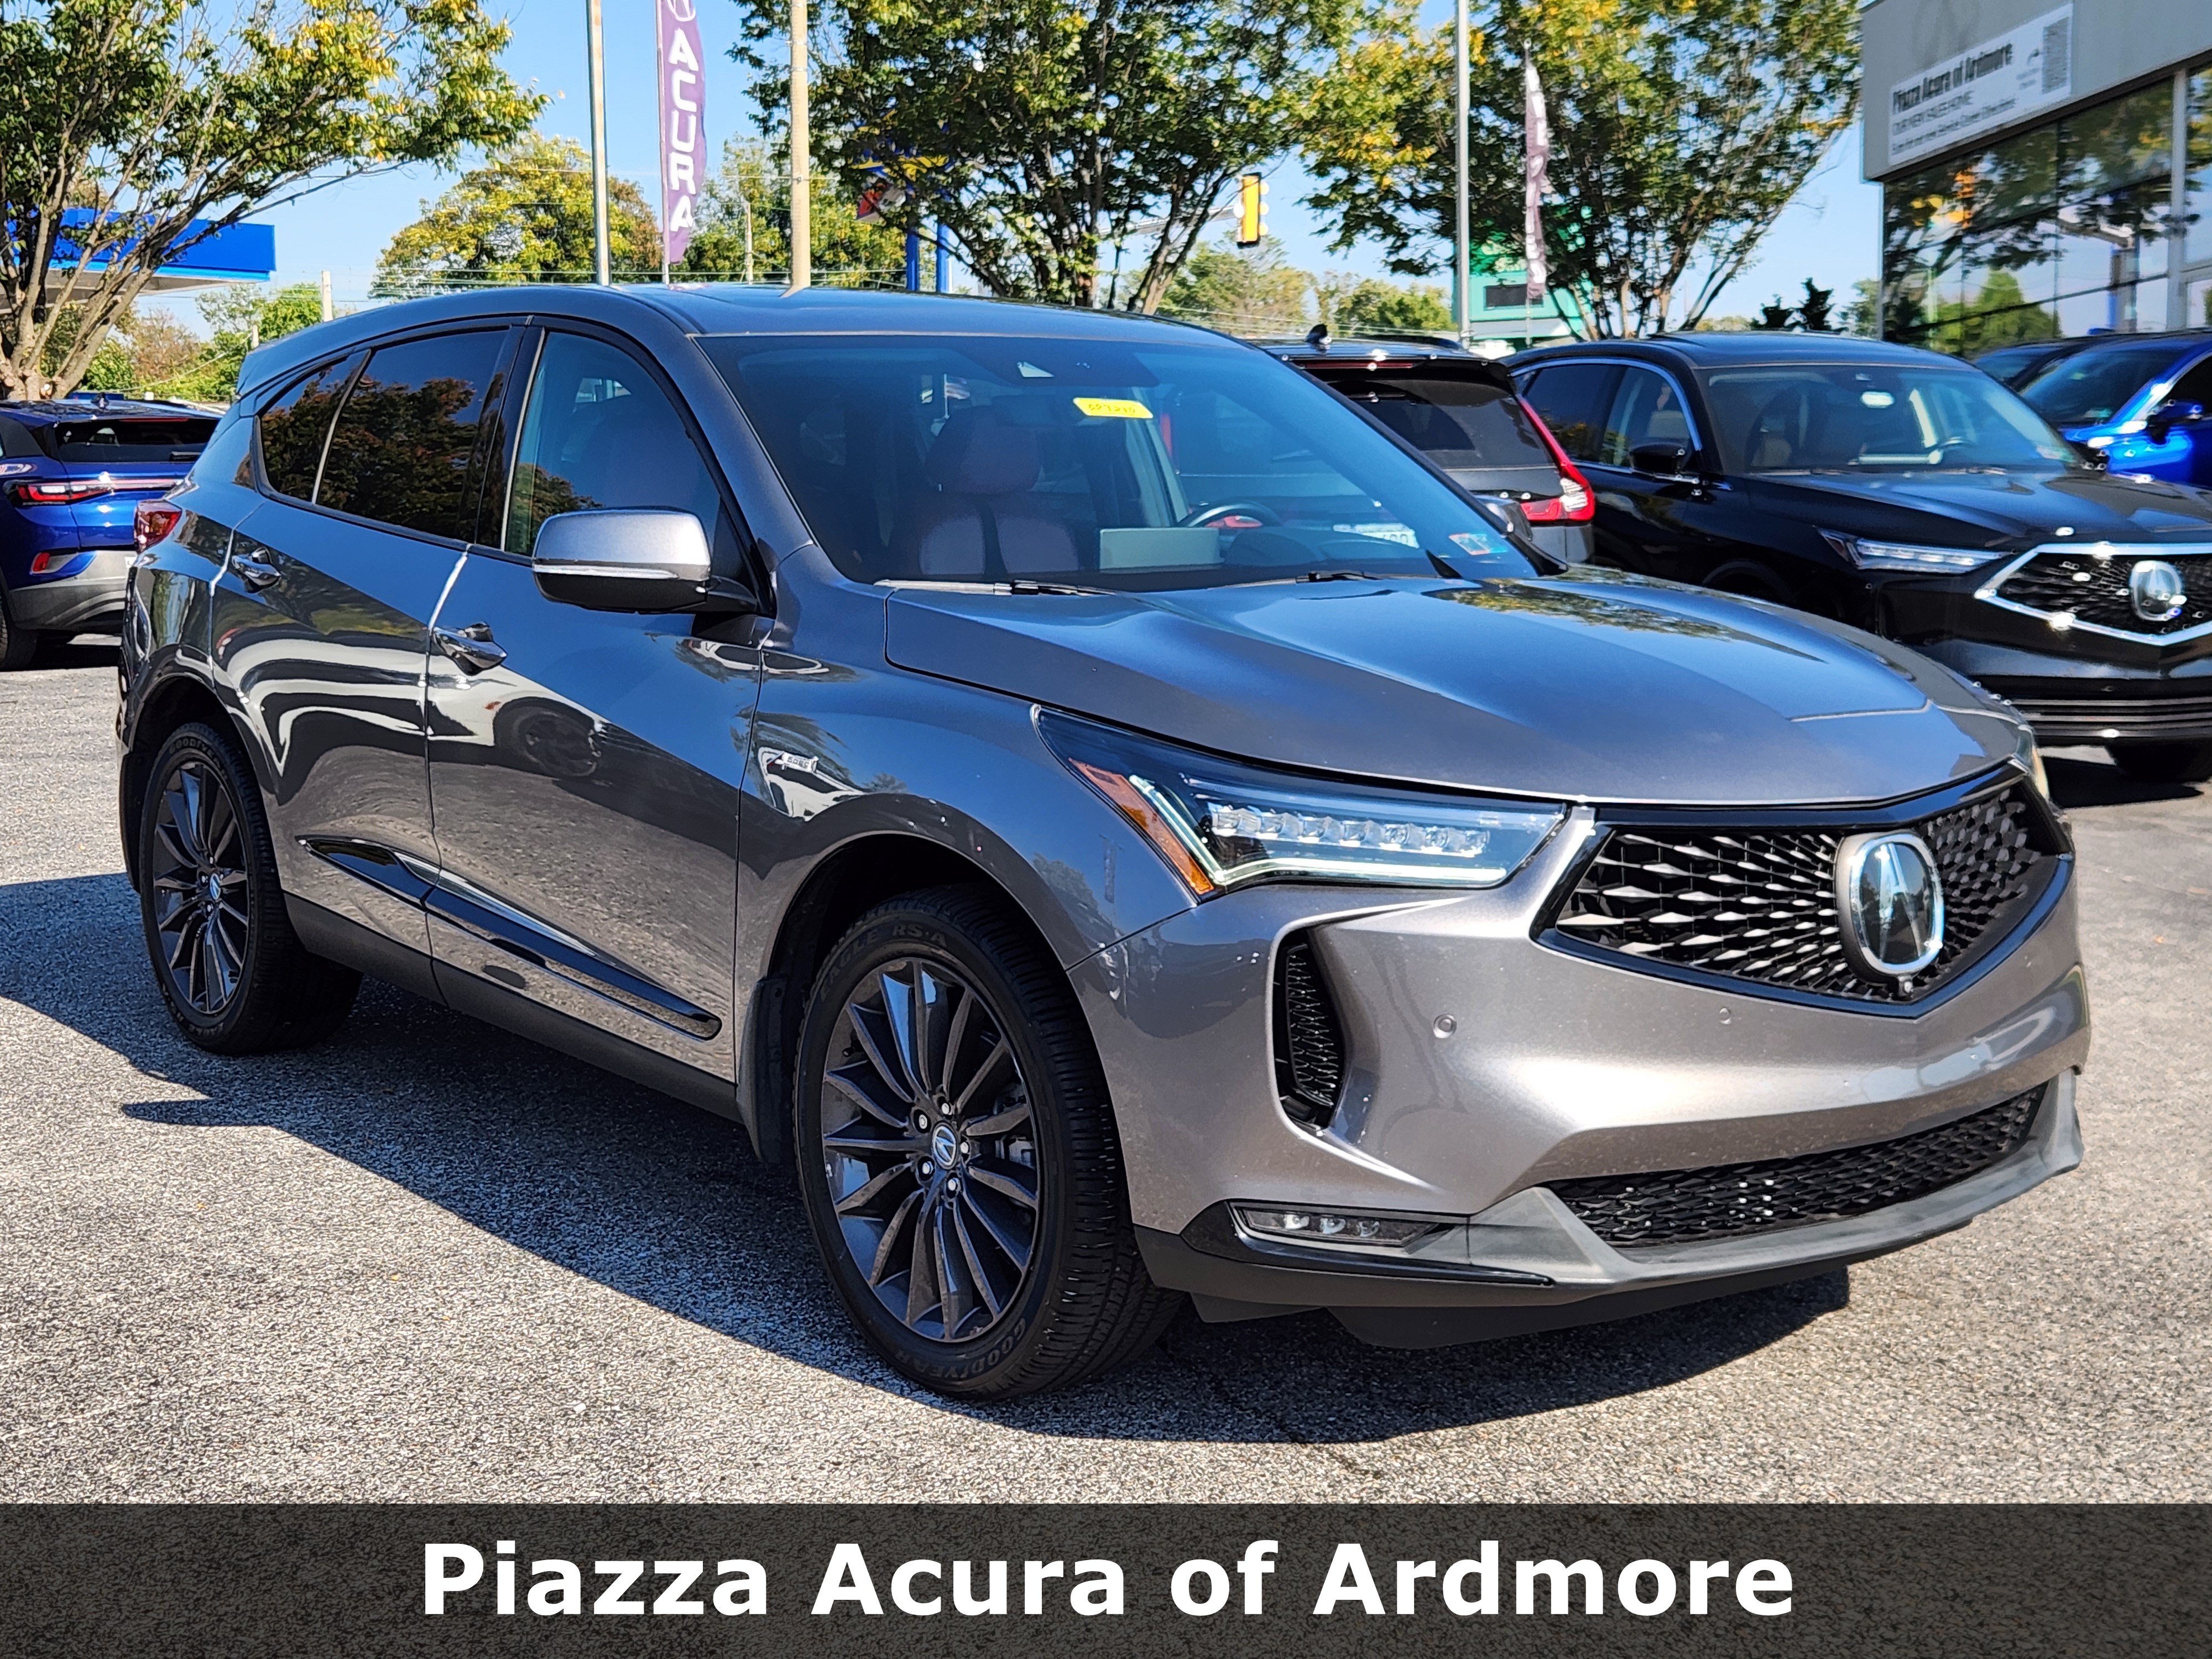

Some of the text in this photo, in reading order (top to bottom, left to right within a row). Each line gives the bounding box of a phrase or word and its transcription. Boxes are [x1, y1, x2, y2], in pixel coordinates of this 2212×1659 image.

[669, 27, 699, 232] ACURA
[820, 929, 878, 1003] EAGLE
[894, 1317, 1026, 1379] GOODYEAR
